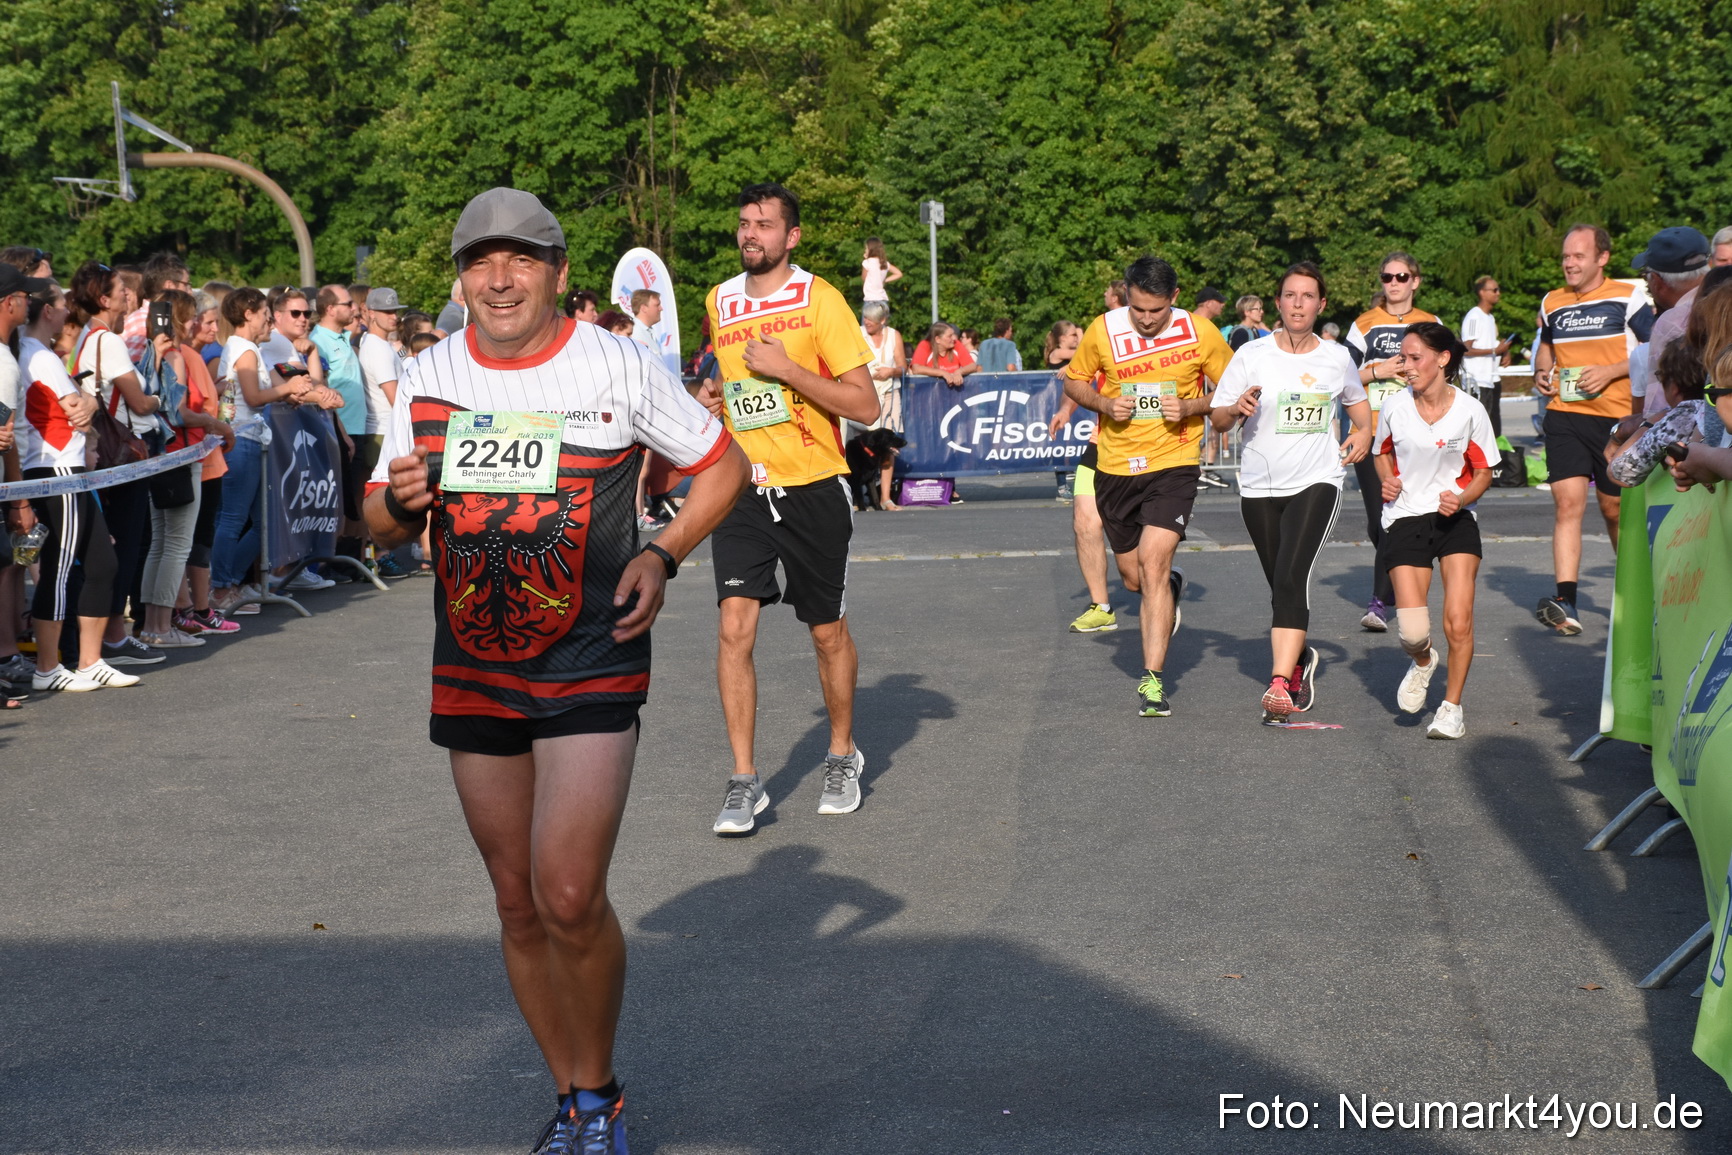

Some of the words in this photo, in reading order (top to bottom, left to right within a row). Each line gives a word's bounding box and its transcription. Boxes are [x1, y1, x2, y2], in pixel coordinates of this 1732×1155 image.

[1562, 315, 1608, 328] Fischer
[1565, 324, 1604, 332] AUTOMOBILE
[718, 326, 755, 349] MAX
[760, 315, 812, 335] BÖGL
[1116, 360, 1157, 380] MAX
[1159, 350, 1200, 369] BÖGL
[733, 392, 777, 416] 1623
[1284, 406, 1323, 421] 1371
[533, 432, 554, 440] 2019
[456, 439, 543, 469] 2240
[461, 469, 506, 479] Behninger
[508, 470, 536, 480] Charly
